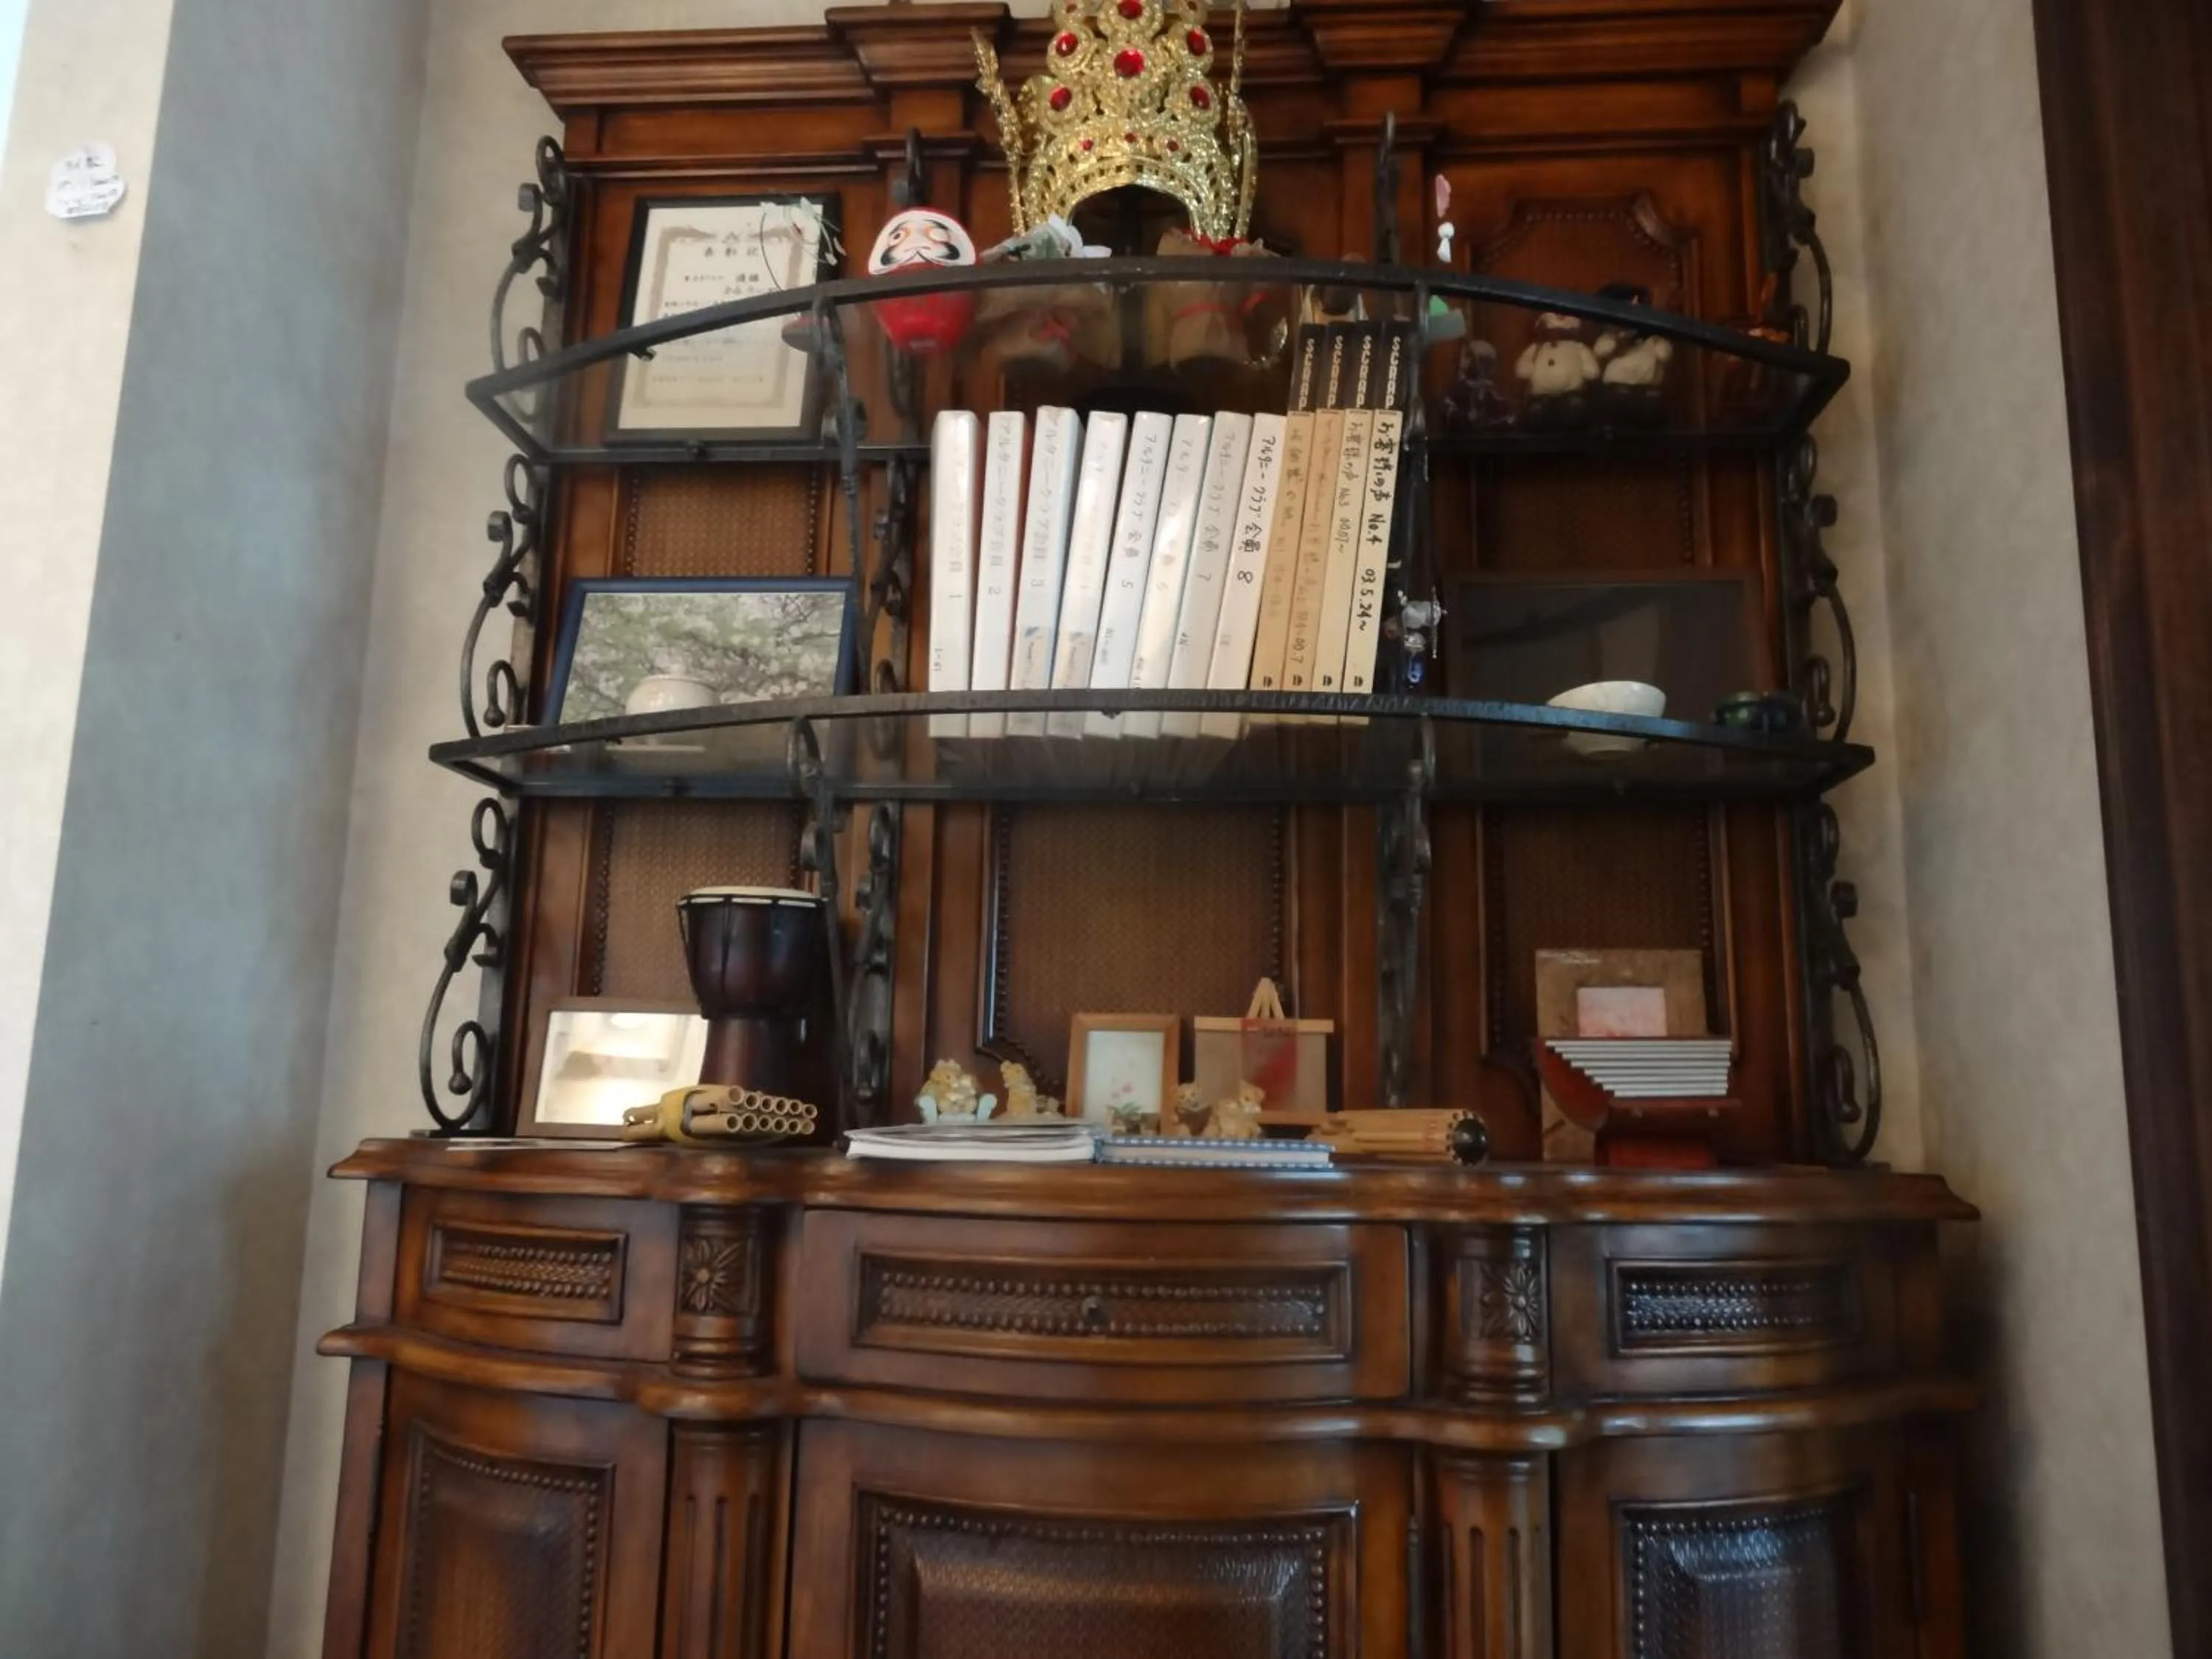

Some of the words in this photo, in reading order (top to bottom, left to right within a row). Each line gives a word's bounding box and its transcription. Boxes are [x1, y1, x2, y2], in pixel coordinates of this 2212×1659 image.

[1298, 338, 1315, 411] SCRAP
[1327, 335, 1343, 409] SCRAP
[1357, 335, 1372, 409] SCRAP
[1385, 335, 1402, 410] SCRAP
[1370, 422, 1396, 502] お客様の声
[1366, 513, 1386, 545] No.4
[1121, 578, 1134, 588] 5
[1197, 572, 1212, 581] 7
[1237, 570, 1253, 583] 8
